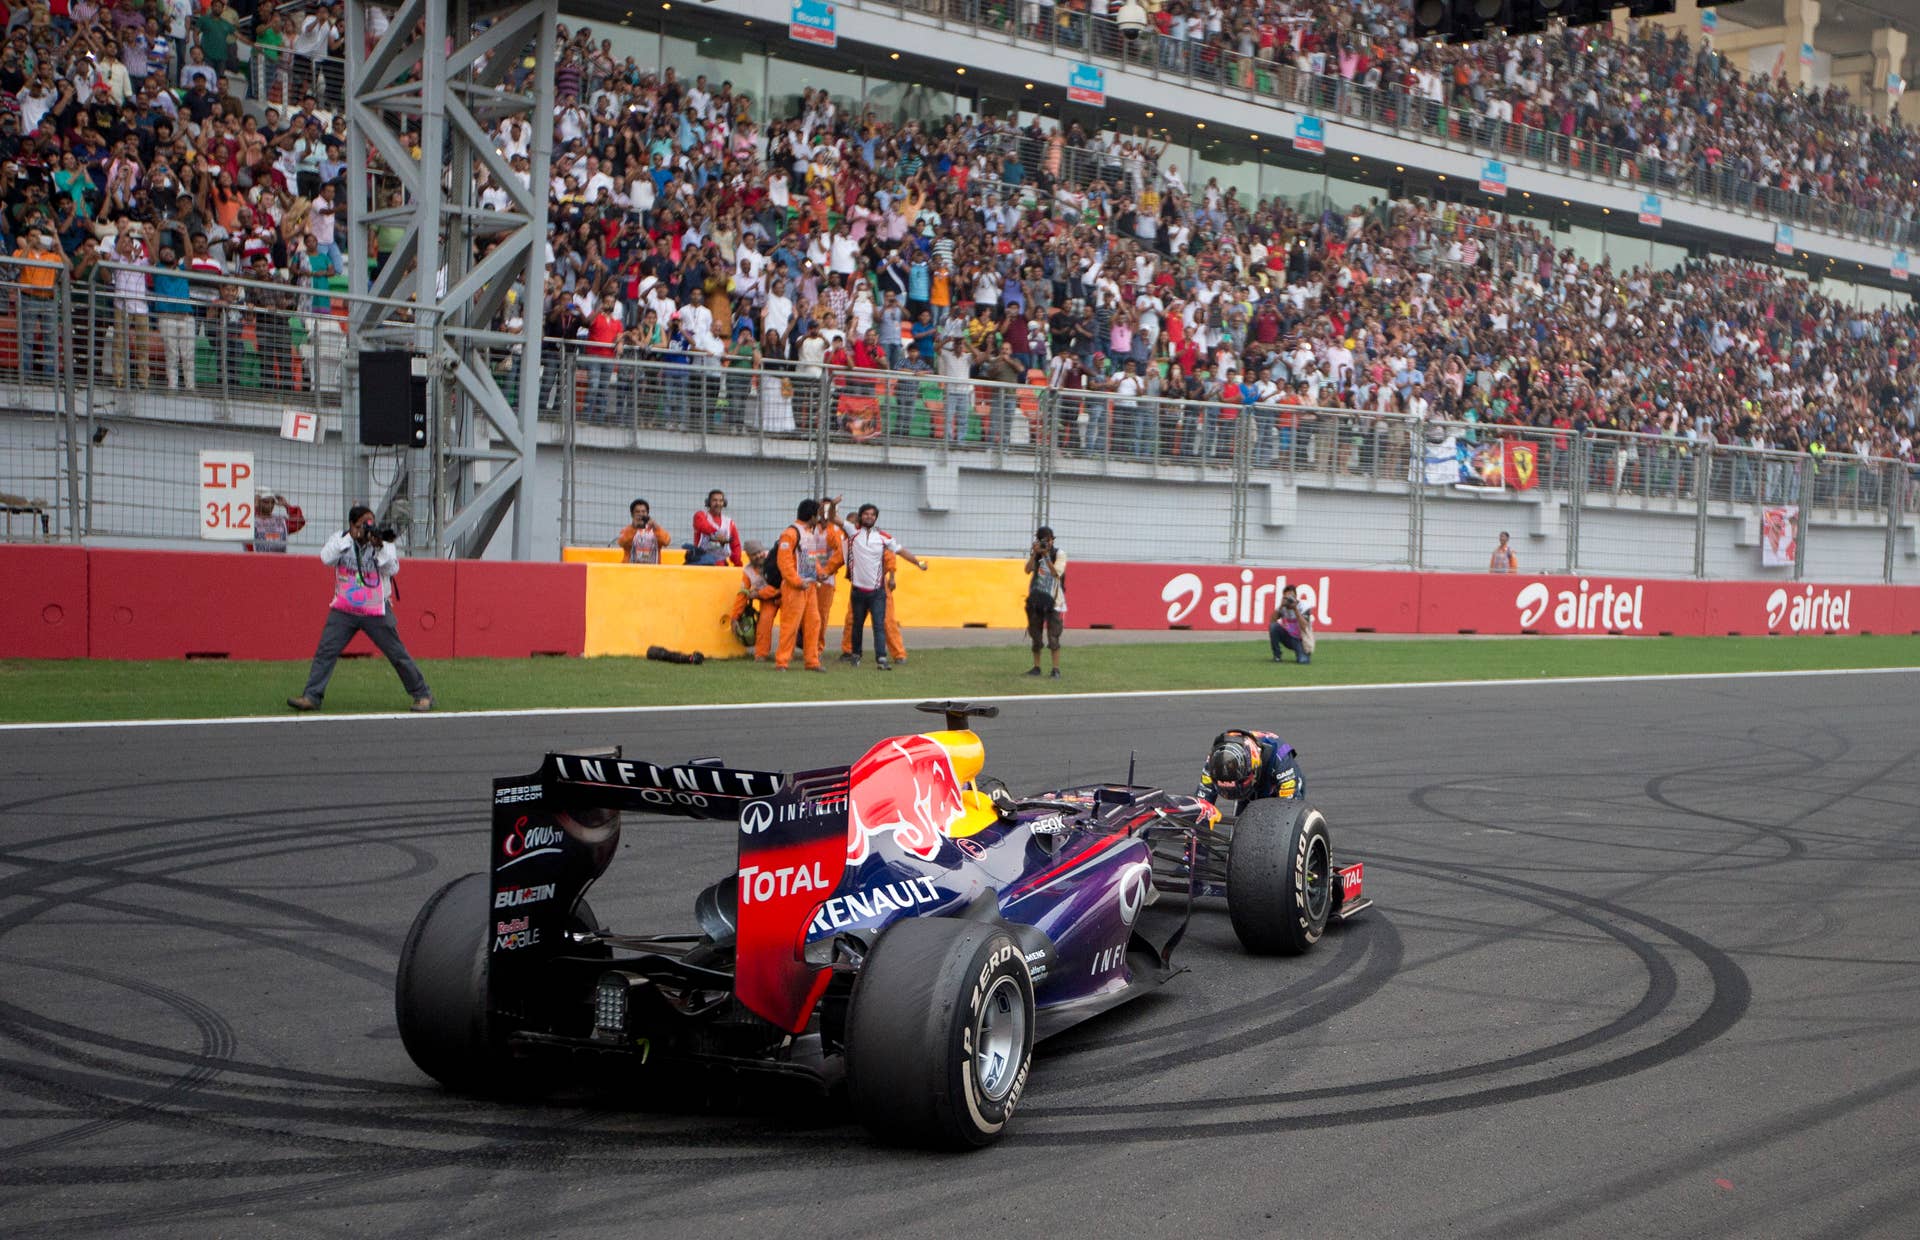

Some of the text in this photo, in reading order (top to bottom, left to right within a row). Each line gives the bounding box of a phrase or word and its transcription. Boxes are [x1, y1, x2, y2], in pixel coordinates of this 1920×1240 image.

[292, 415, 311, 438] F
[203, 462, 251, 489] IP
[205, 502, 251, 529] 31.2
[1554, 579, 1643, 630] airtel
[1789, 584, 1850, 632] airtel
[555, 756, 780, 796] INFINITI
[738, 862, 830, 905] TOTAL
[1341, 868, 1362, 889] TAL
[808, 875, 940, 934] RENAULT
[1090, 942, 1127, 976] INFI
